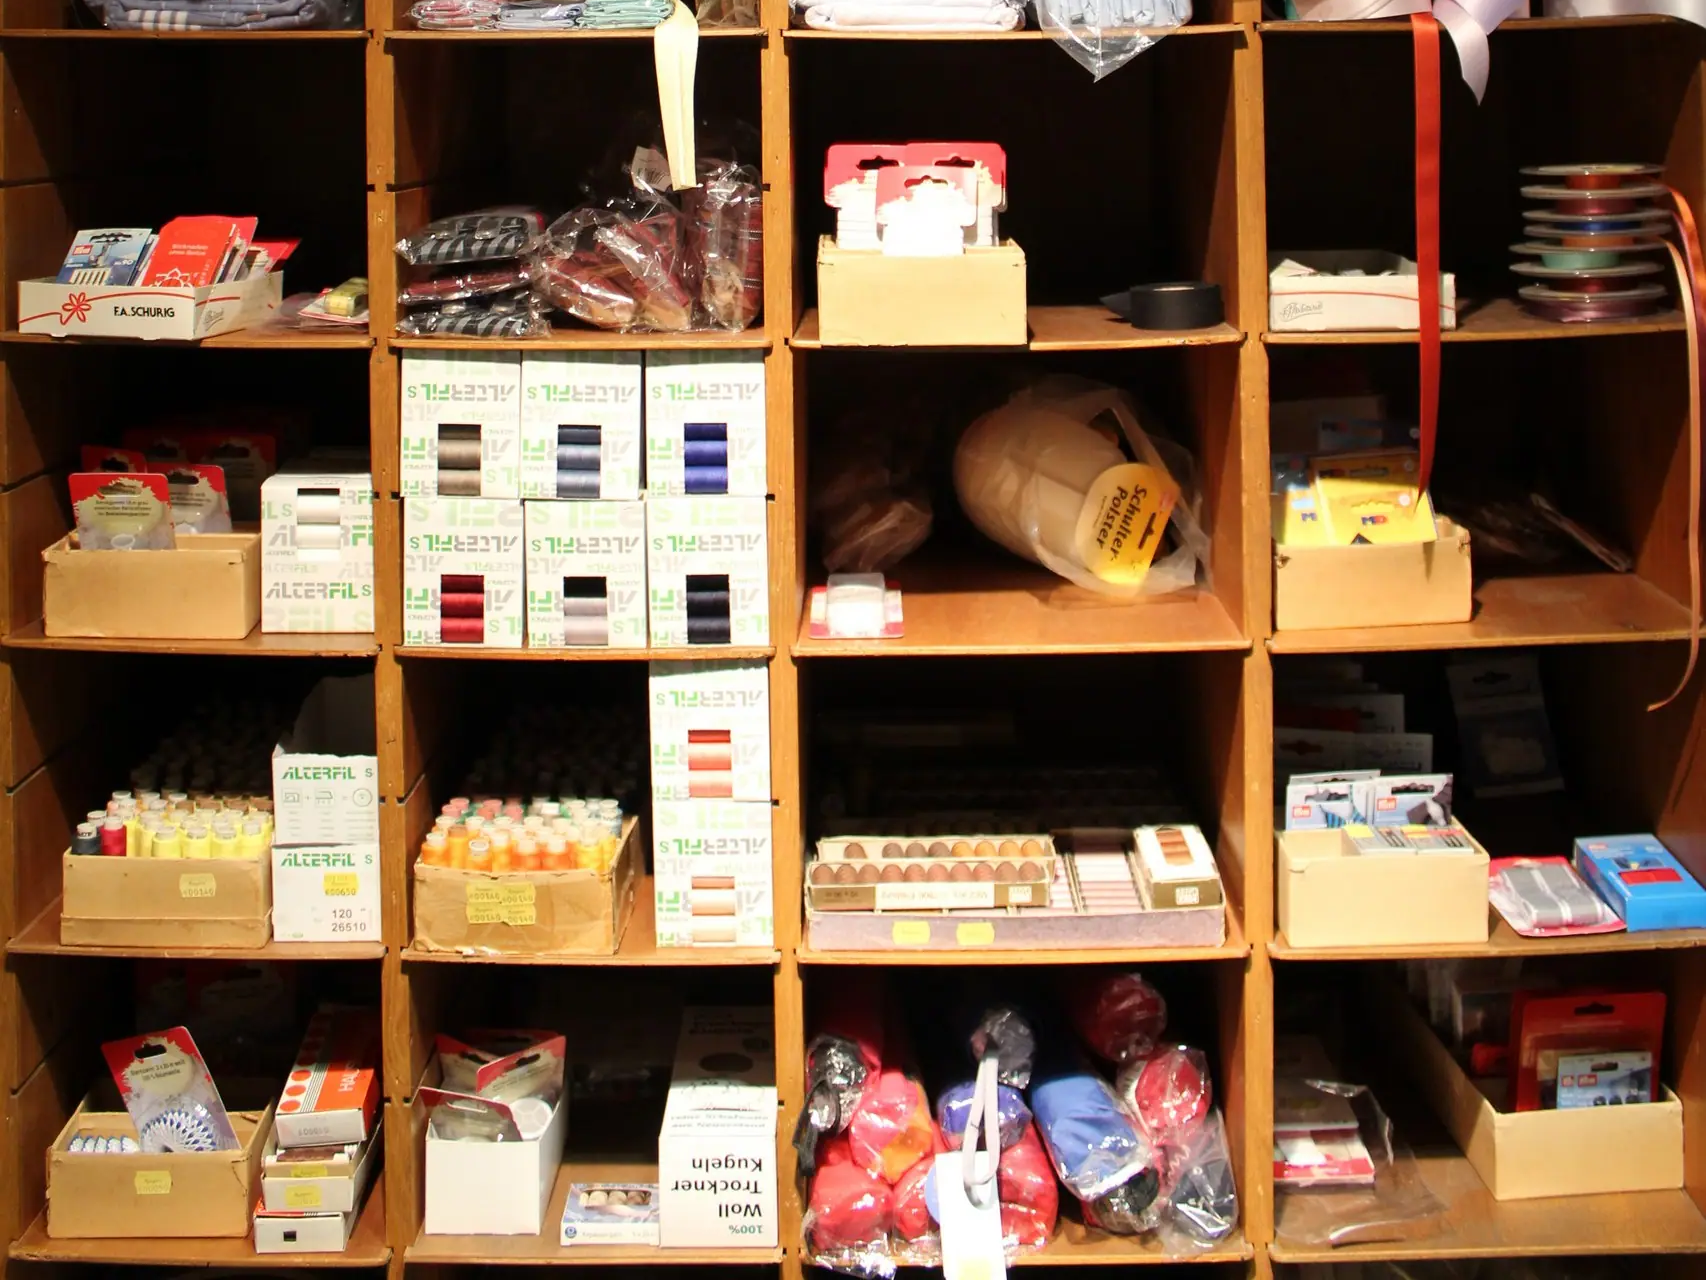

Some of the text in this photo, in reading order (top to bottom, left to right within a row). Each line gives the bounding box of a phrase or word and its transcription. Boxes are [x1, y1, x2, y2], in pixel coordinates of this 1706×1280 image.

[1096, 486, 1128, 549] Polster
[281, 766, 356, 780] ALTERFIL
[281, 853, 355, 867] ALTERFIL
[331, 909, 353, 919] 120
[691, 1154, 763, 1173] Kugeln
[671, 1179, 763, 1195] Trockner
[718, 1203, 763, 1218] Woll
[728, 1224, 763, 1235] 100%
